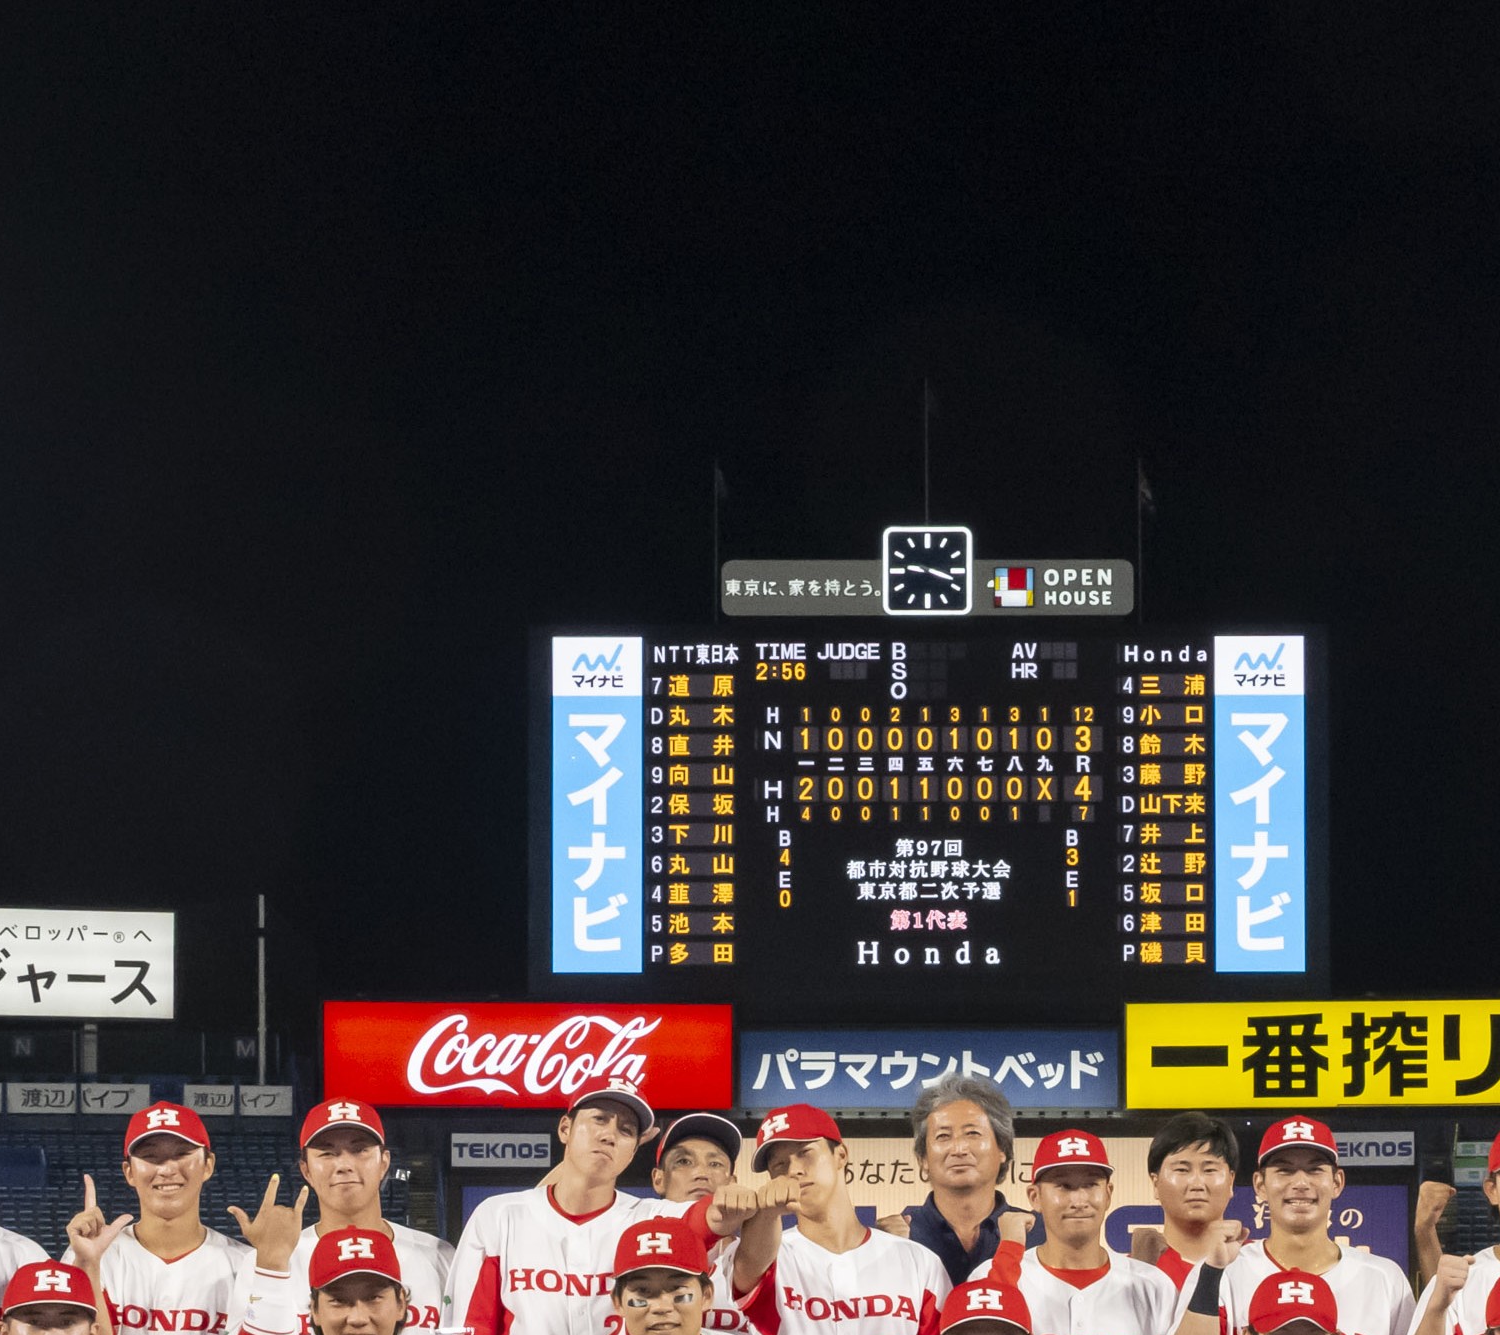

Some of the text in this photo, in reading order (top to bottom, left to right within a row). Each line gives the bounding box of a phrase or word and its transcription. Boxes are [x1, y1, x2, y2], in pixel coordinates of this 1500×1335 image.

[725, 577, 883, 599] 東京に、家を持とう。
[1043, 568, 1112, 587] OPEN
[1044, 590, 1112, 606] HOUSE
[755, 642, 881, 660] TIME JUDGE
[892, 642, 907, 661] B
[1011, 642, 1037, 659] AV
[1124, 644, 1208, 663] Honda
[572, 674, 624, 688] マイナビ
[755, 662, 806, 681] 2:56
[891, 662, 907, 680] S
[1011, 662, 1038, 679] HR
[1234, 673, 1286, 687] マイナビ
[668, 674, 734, 697] 道原
[890, 681, 907, 700] O
[1139, 674, 1206, 696] 三浦
[668, 704, 735, 726] 丸木
[1139, 704, 1204, 726] 小口
[668, 733, 735, 757] 直井
[764, 726, 1092, 752] N 1 0 0 0 0 1 0 1 0 3
[1139, 733, 1206, 755] 鈴木
[669, 763, 734, 786] 向山
[1139, 762, 1206, 786] 藤野
[764, 780, 782, 799] H
[798, 777, 814, 801] 2
[827, 777, 844, 801] 0
[857, 777, 873, 801] 0
[889, 777, 899, 800] 1
[919, 777, 929, 800] 1
[947, 777, 963, 800] 0
[976, 776, 993, 800] 0
[1006, 777, 1023, 800] 0
[1074, 775, 1092, 802] 4
[668, 793, 734, 815] 保坂
[1140, 792, 1206, 815] 山下来
[567, 714, 629, 952] マイナビ
[668, 824, 733, 845] 下川
[1140, 822, 1206, 845] 井上
[1229, 713, 1292, 951] マイナビ
[895, 838, 963, 858] 第97回
[668, 853, 734, 875] 丸山
[846, 859, 1012, 880] 都市対抗野球大会
[1139, 852, 1207, 875] 辻野
[856, 881, 1002, 901] 東京都二次予選
[1140, 881, 1204, 904] 坂口
[668, 912, 735, 934] 池本
[890, 909, 968, 931] 第1代表
[1140, 911, 1205, 934] 津田
[669, 942, 733, 965] 多田
[857, 940, 1001, 965] Honda
[1139, 941, 1206, 964] 磯貝
[407, 1014, 662, 1096] Coca-Cola
[753, 1047, 1104, 1092] パラマウントベッド
[20, 1086, 136, 1109] 渡辺パイプ
[453, 1141, 549, 1159] TEKNOS
[1337, 1141, 1413, 1158] EKNOS
[509, 1268, 613, 1297] HON
[784, 1286, 918, 1322] HONDA
